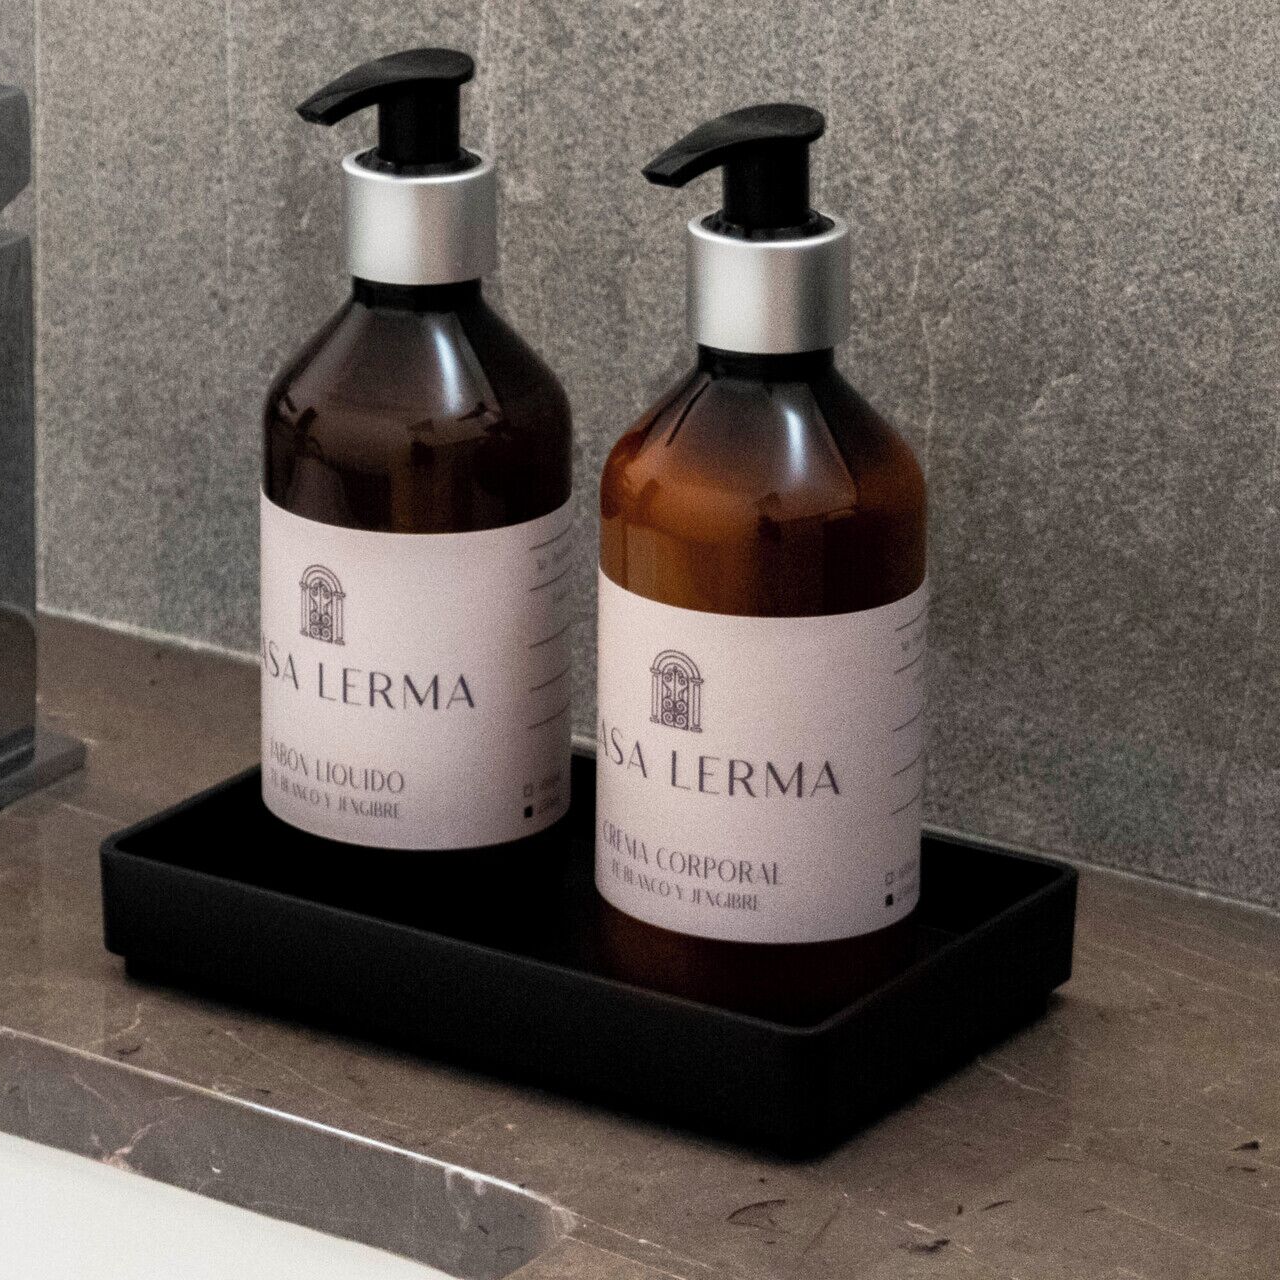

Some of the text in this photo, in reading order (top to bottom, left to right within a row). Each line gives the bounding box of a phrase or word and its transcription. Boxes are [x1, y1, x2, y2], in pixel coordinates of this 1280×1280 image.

[318, 662, 475, 710] LERMA
[671, 749, 841, 799] LERMA
[603, 820, 784, 886] CREMA CORPORAL
